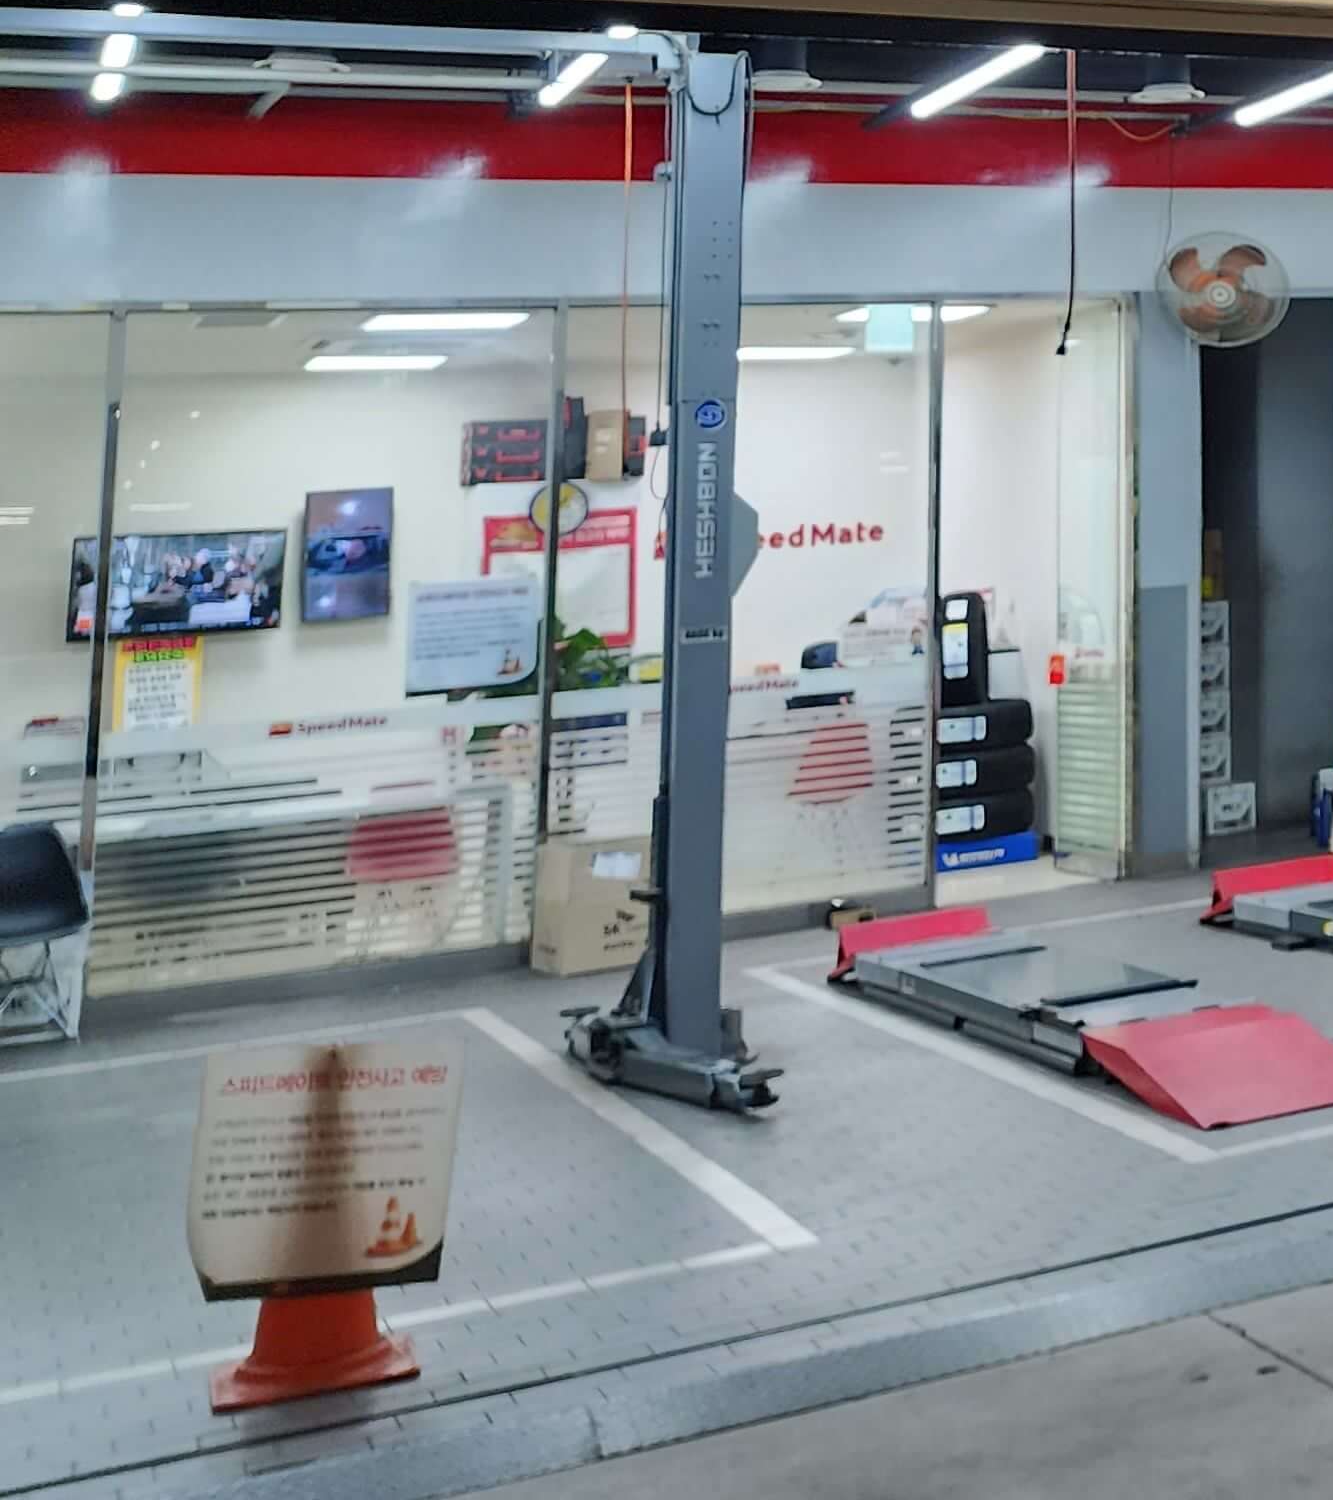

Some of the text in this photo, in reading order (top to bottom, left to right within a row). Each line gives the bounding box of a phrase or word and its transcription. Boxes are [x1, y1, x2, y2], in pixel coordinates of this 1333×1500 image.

[696, 442, 717, 579] HESHBON
[757, 521, 884, 550] edMate
[298, 716, 388, 737] SpeedMate
